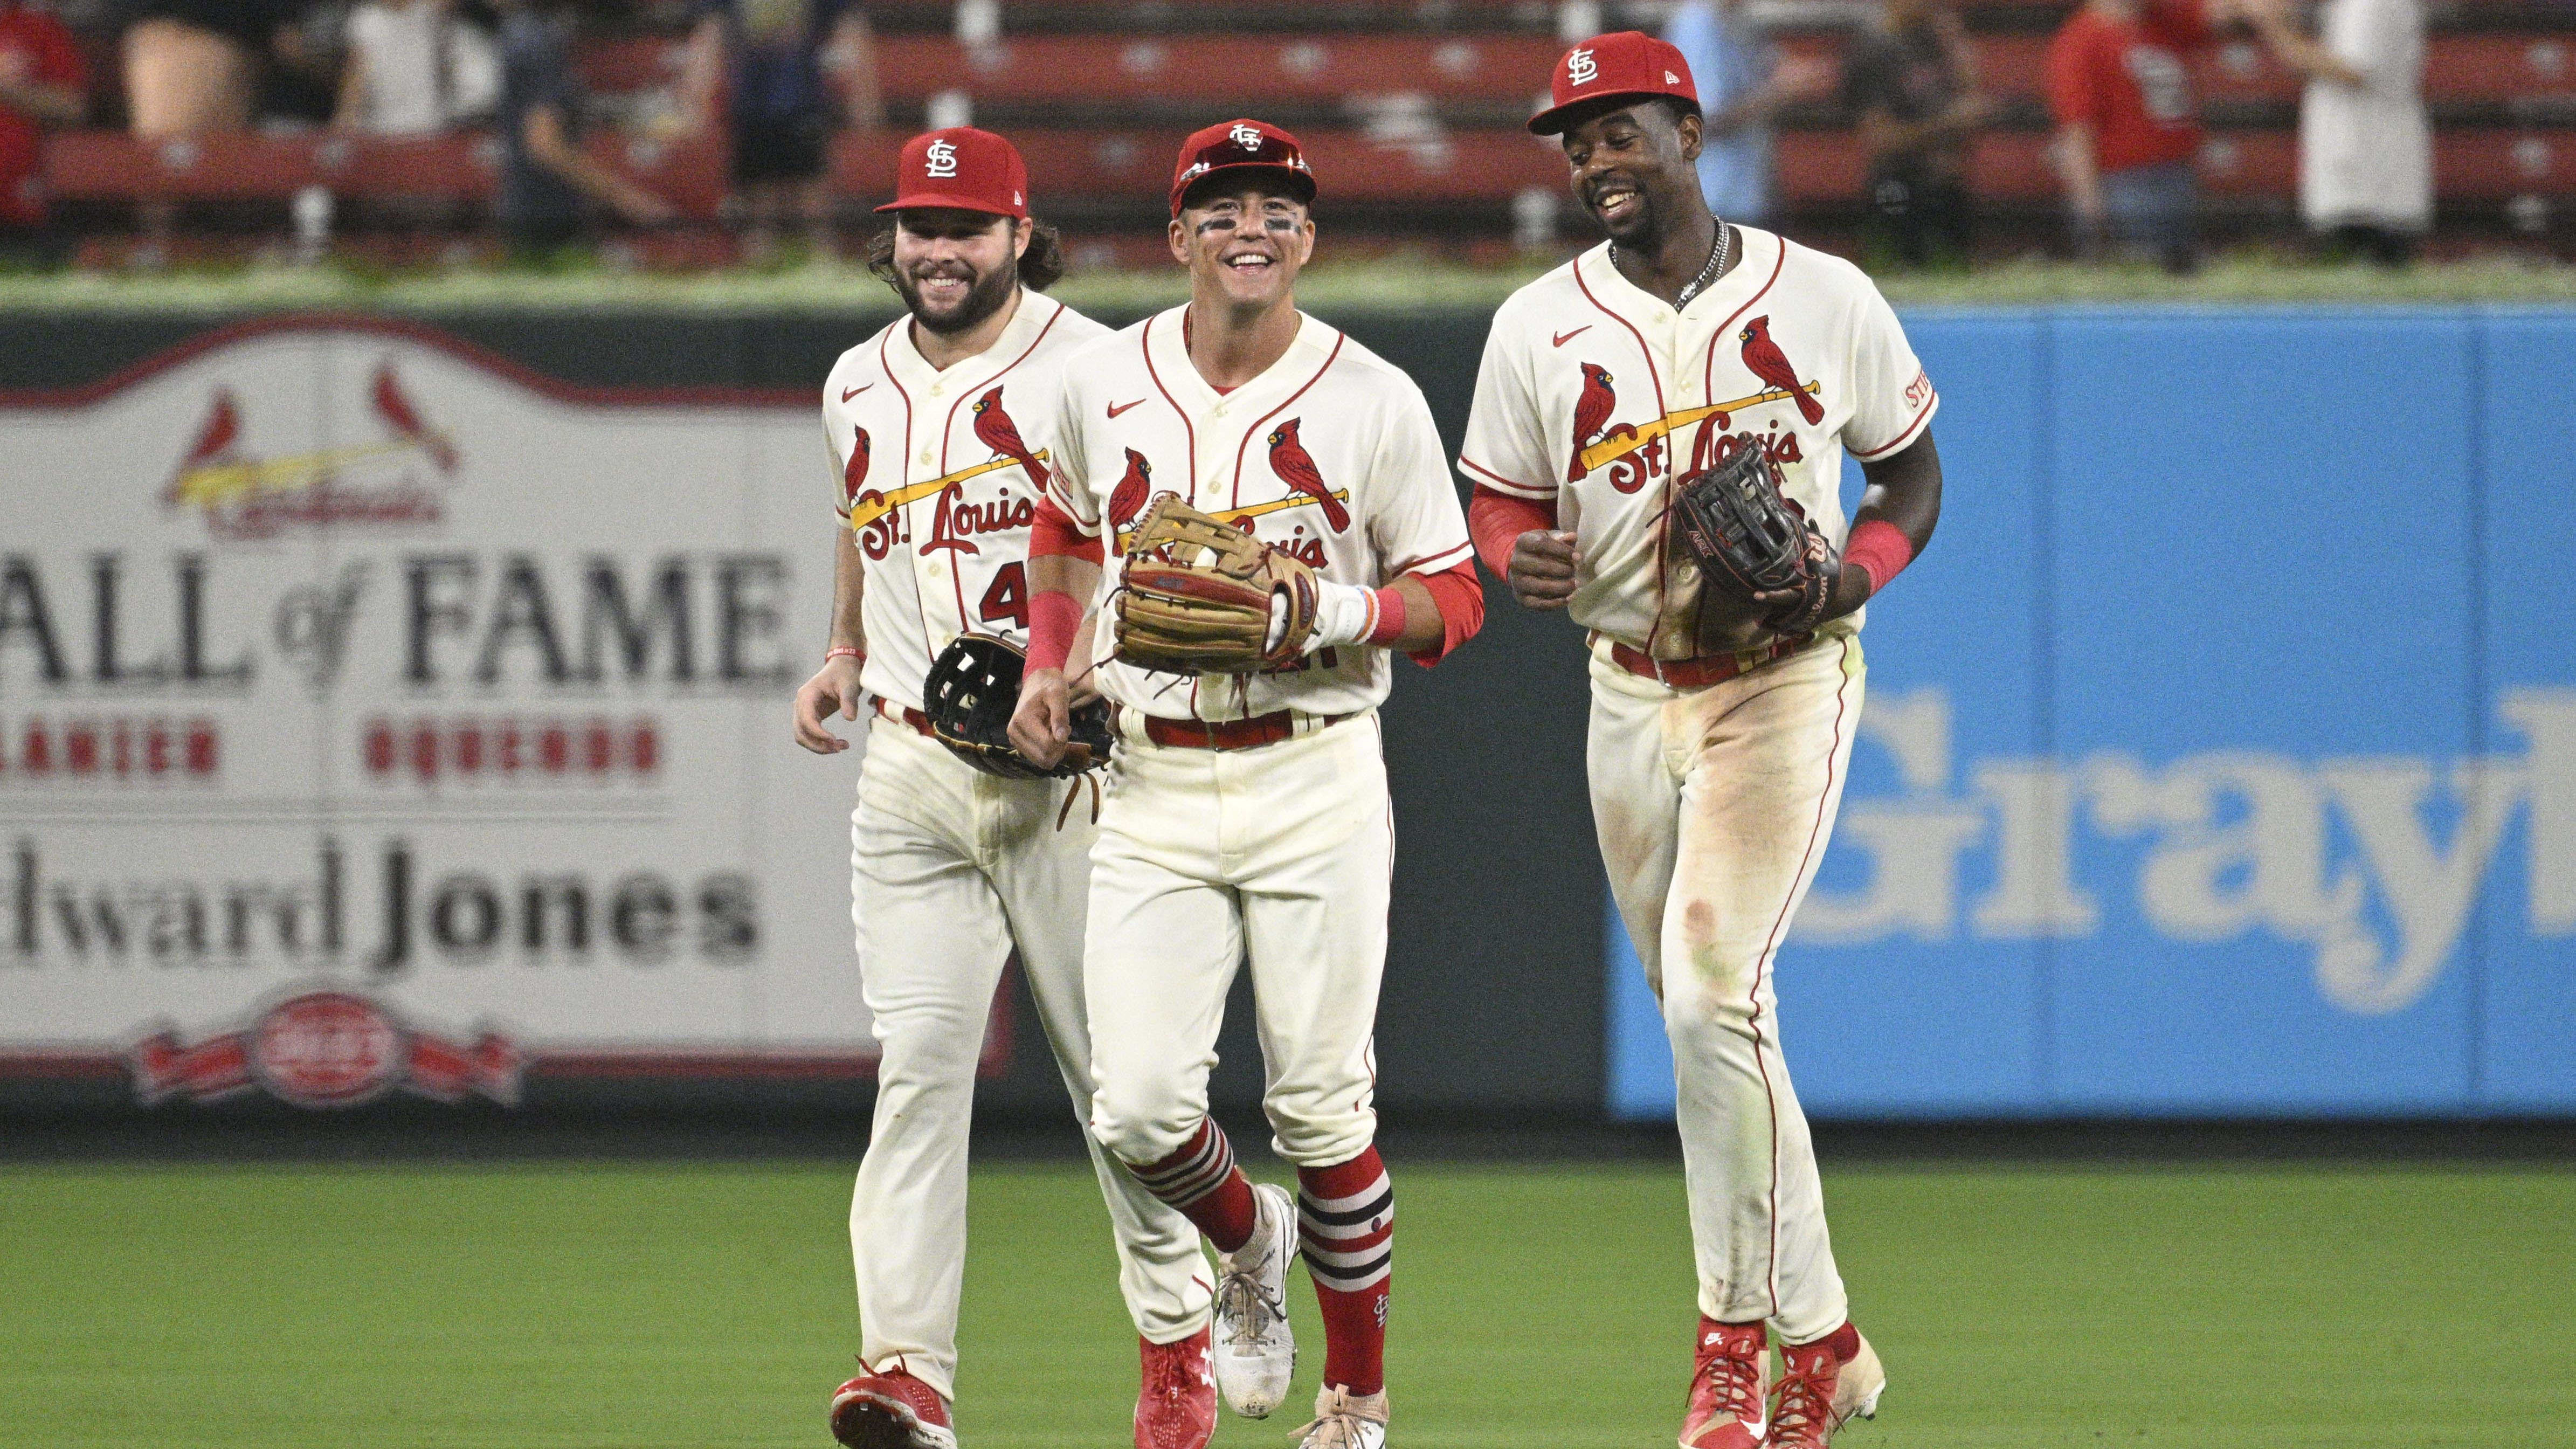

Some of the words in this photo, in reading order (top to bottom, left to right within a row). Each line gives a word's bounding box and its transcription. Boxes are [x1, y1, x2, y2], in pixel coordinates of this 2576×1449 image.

[859, 488, 911, 561] St.
[918, 482, 1034, 556] Louis
[0, 550, 258, 693] ALL
[272, 558, 373, 703] of
[402, 550, 797, 693] FAME
[0, 715, 222, 779] ANIER
[360, 833, 762, 986] Jones
